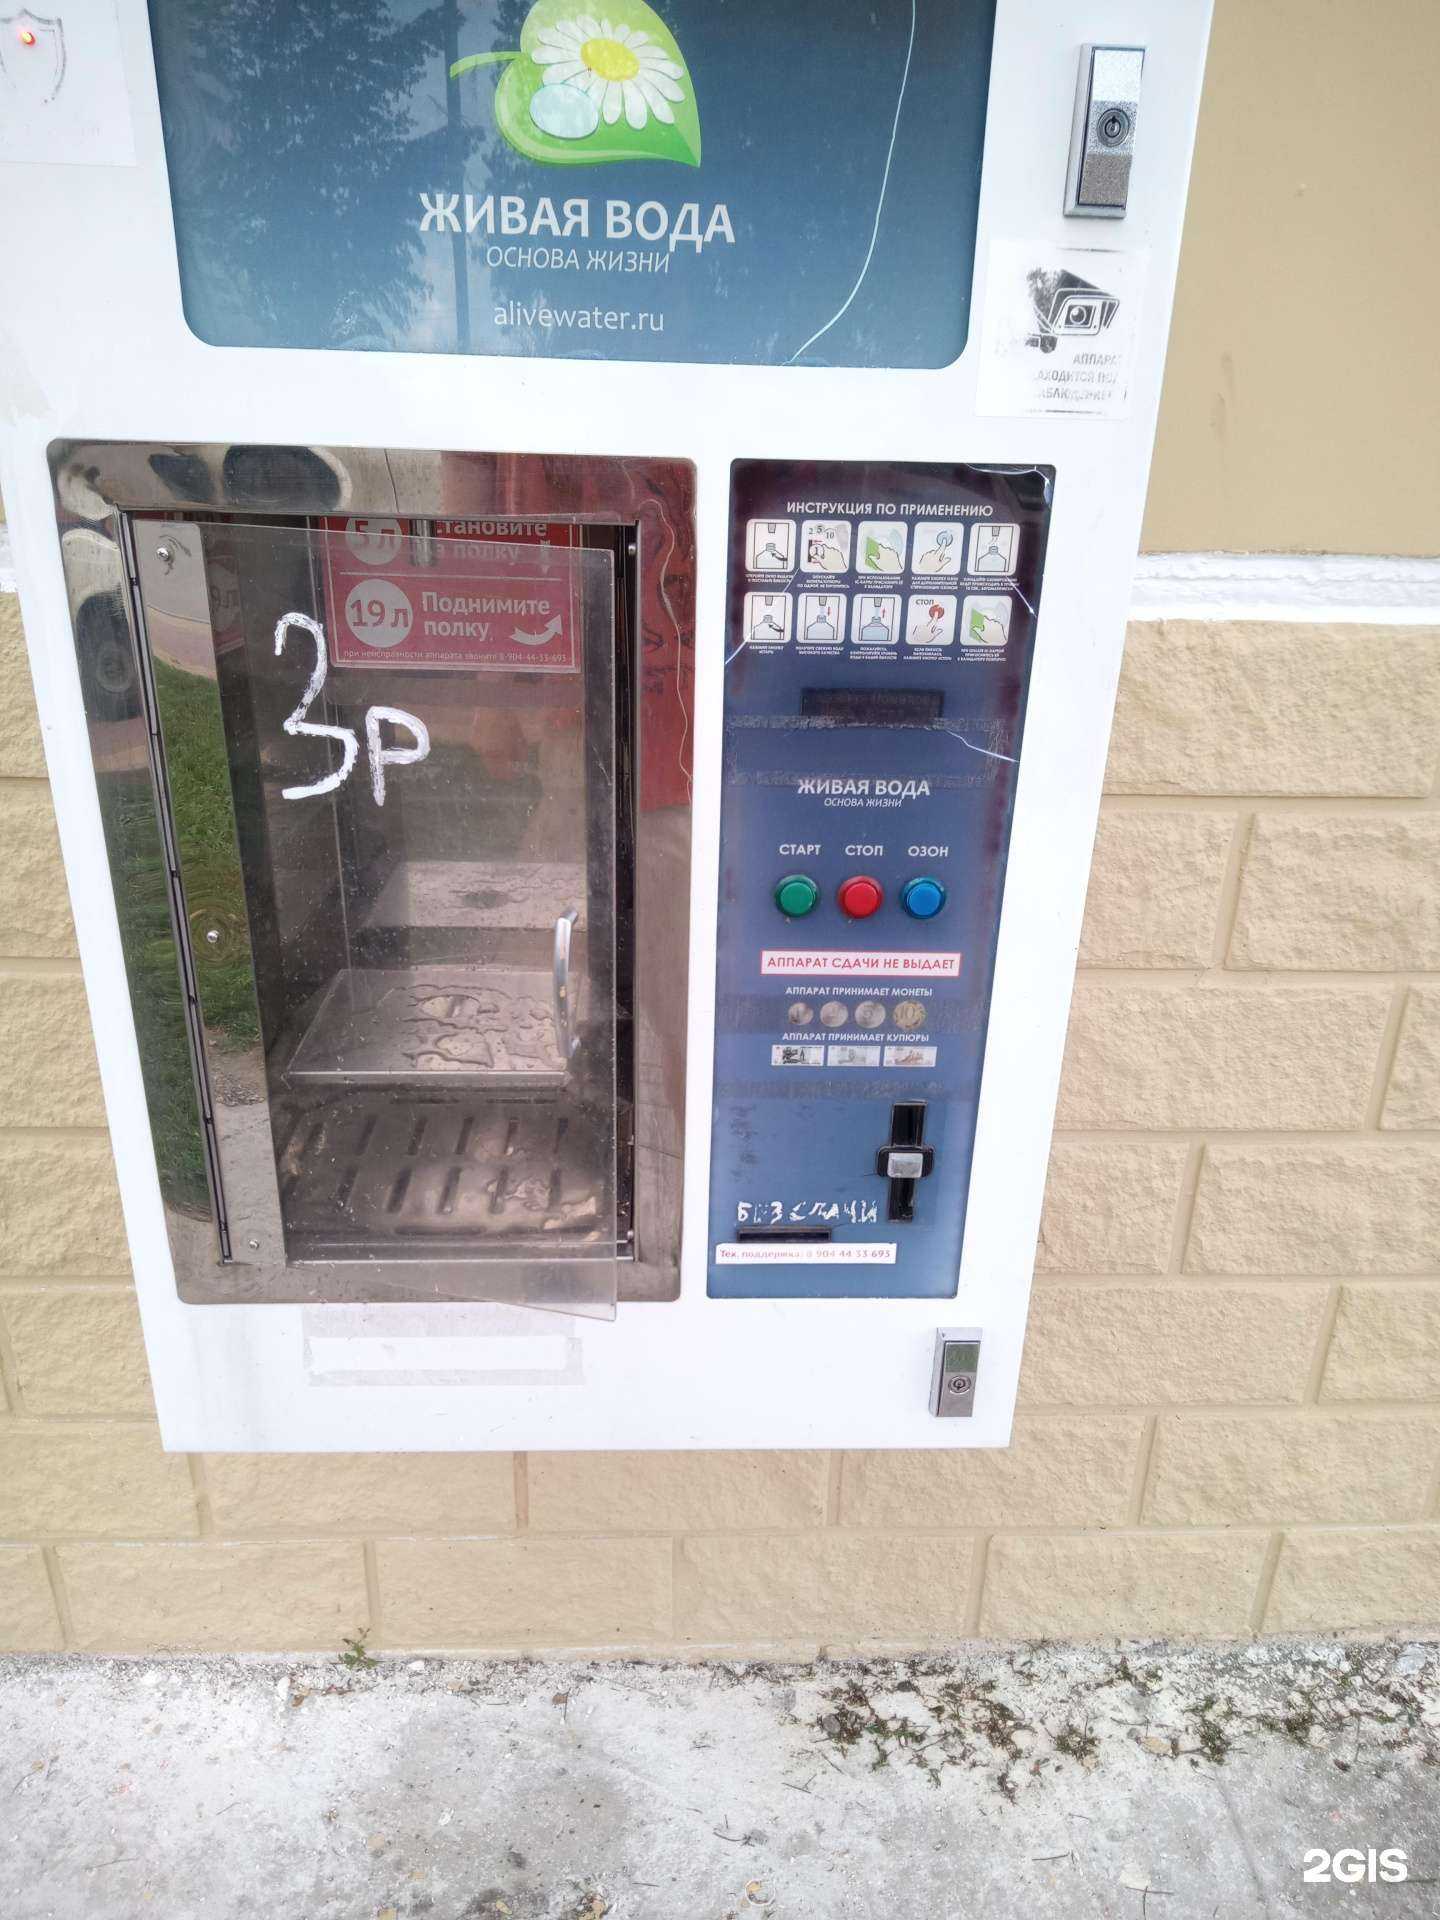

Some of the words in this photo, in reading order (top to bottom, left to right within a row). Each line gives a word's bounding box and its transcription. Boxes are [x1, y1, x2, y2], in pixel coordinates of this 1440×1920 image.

[419, 193, 589, 237] ЖИВАЯ
[606, 199, 736, 253] ВОДА
[486, 246, 580, 269] ОСНОВА
[586, 251, 670, 273] ЖИЗНИ
[494, 301, 665, 332] alivewater.ru
[1072, 352, 1121, 365] АППАРА
[786, 501, 872, 515] ИНСТРУКЦИЯ
[876, 503, 896, 515] ПО
[900, 504, 994, 517] ПРИМЕНЕНИЮ
[436, 520, 548, 538] тановите
[350, 599, 387, 628] 19
[391, 607, 410, 628] л
[421, 591, 551, 616] Поднимите
[424, 621, 490, 642] полку
[797, 779, 869, 796] ЖИВАЯ
[875, 780, 931, 799] ВОДА
[824, 797, 864, 807] ОСНОВА
[865, 798, 902, 808] ЖИЗНИ
[779, 844, 822, 856] СТАРТ
[845, 845, 884, 857] СТОП
[907, 846, 949, 858] ОЗОН
[767, 957, 828, 969] АППАРАТ
[832, 957, 880, 970] СДАЧИ
[883, 958, 899, 970] НЕ
[903, 958, 955, 971] ВЫДАЕТ
[785, 986, 831, 996] АППАРАТ
[832, 987, 889, 997] ПРИНИМАЕТ
[891, 987, 933, 998] МОНЕТЫ
[782, 1032, 827, 1042] АППАРАТ
[828, 1032, 885, 1043] ПРИНИМАЕТ
[886, 1033, 930, 1043] КУПЮРЫ
